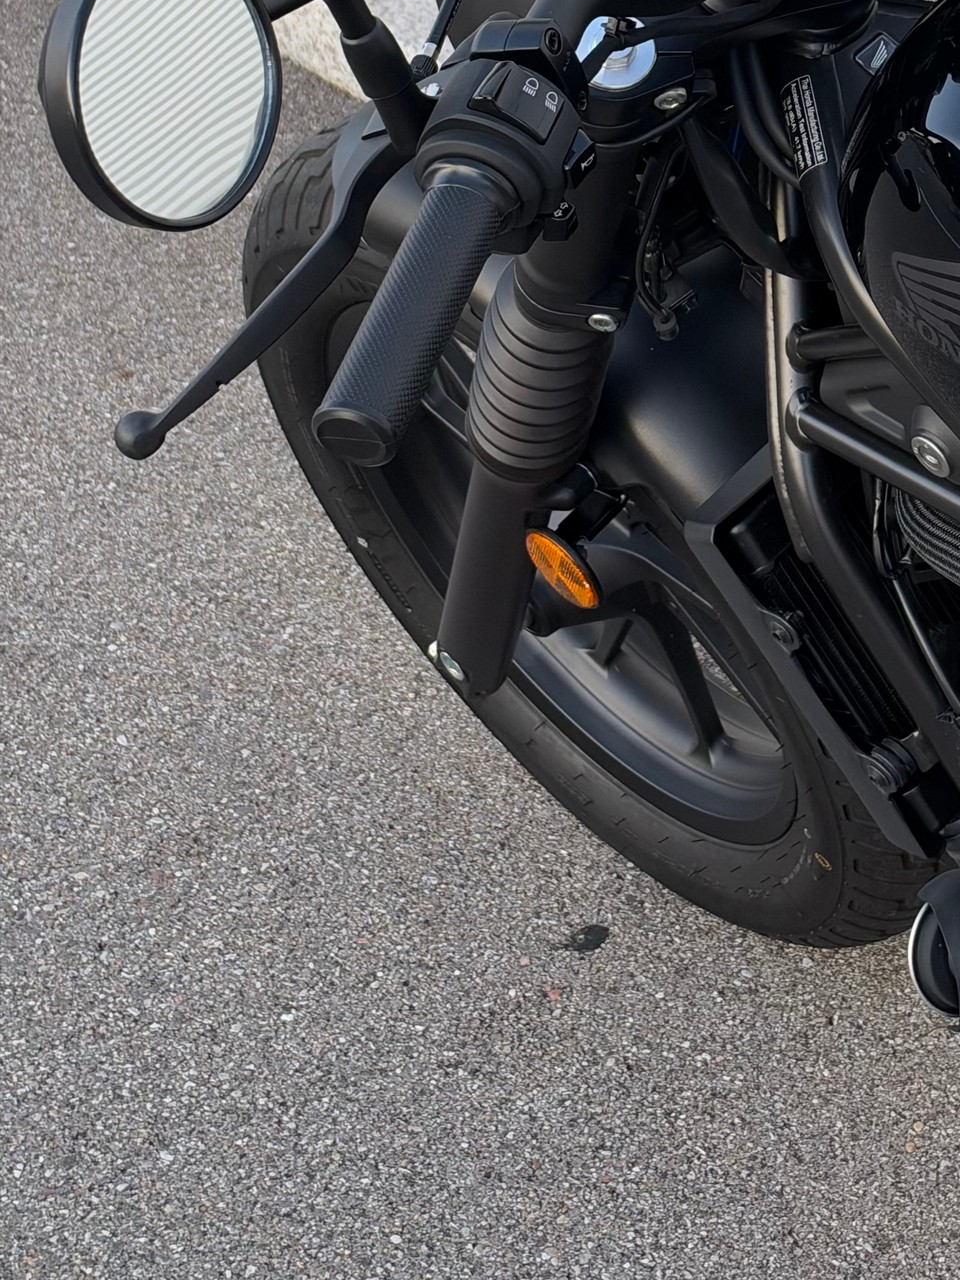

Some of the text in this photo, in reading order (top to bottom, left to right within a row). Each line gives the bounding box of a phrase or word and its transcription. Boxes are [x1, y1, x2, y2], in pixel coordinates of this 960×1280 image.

[803, 90, 812, 107] Honda
[790, 83, 802, 119] Acceleration
[801, 133, 812, 166] Information
[807, 107, 820, 142] Manufacturing
